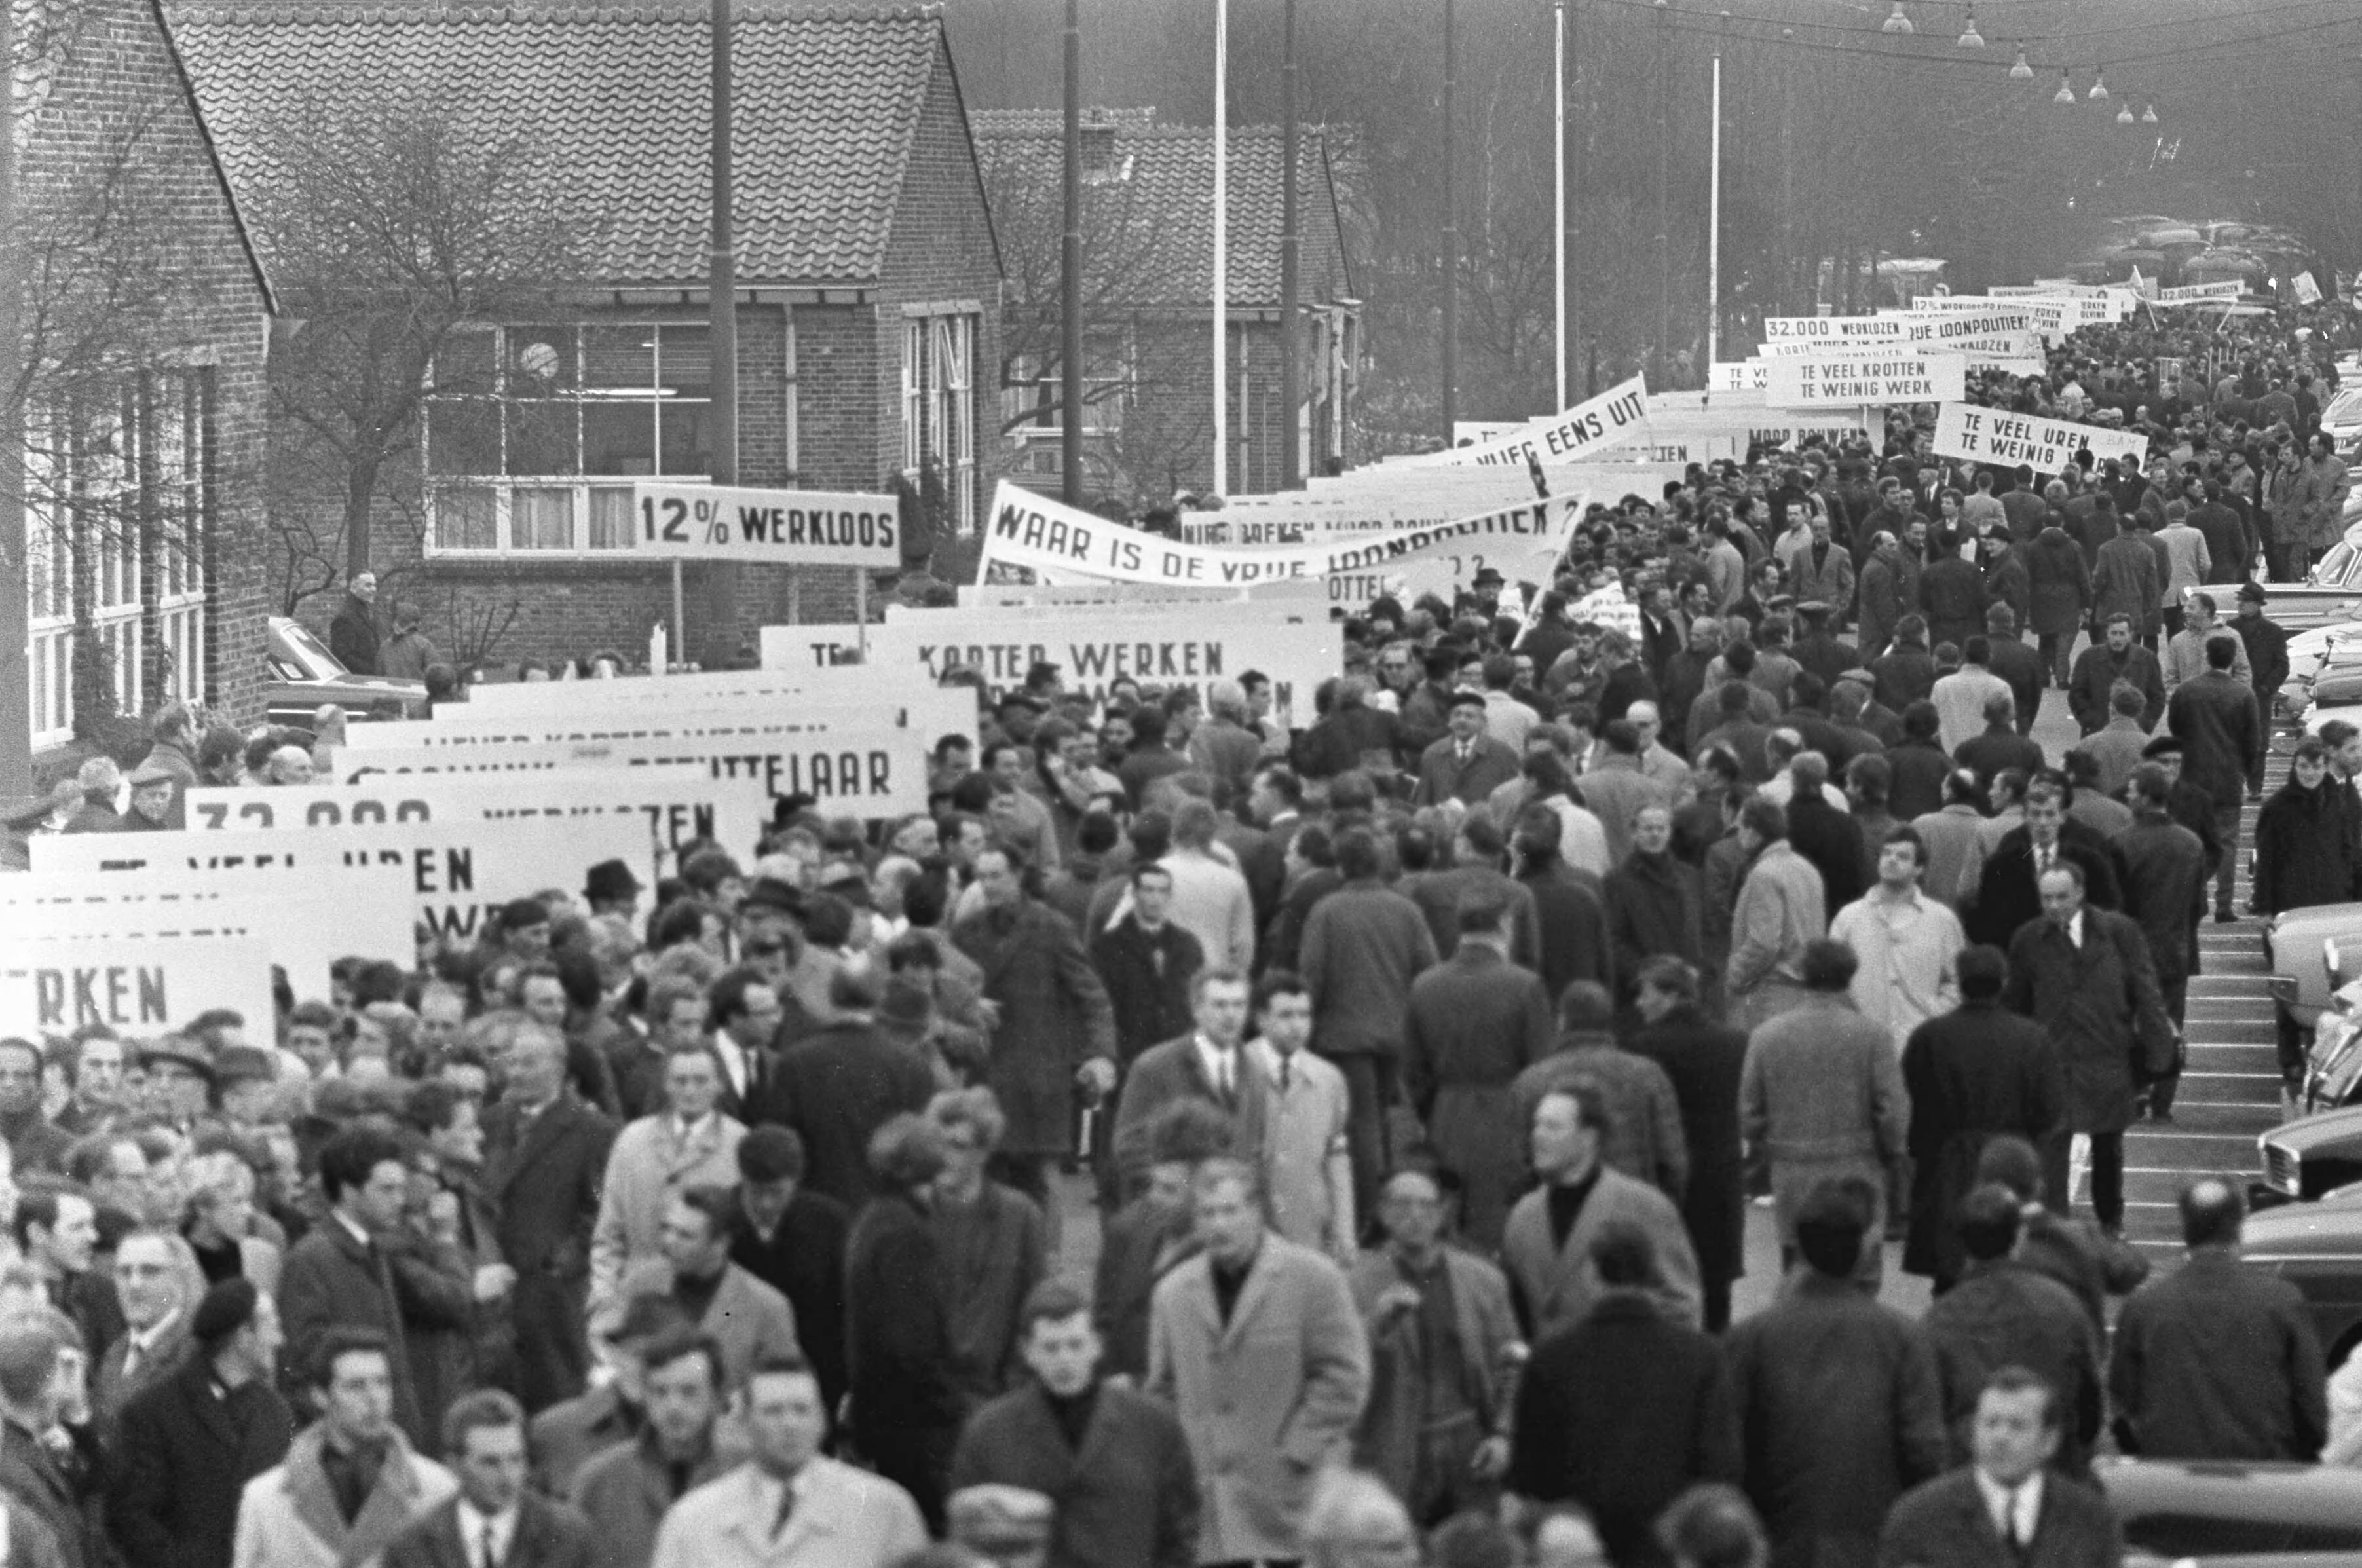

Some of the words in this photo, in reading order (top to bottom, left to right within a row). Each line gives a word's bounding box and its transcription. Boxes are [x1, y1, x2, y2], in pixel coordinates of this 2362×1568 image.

[1768, 320, 1829, 337] 32.000
[1841, 322, 1900, 335] WERKLOZEN
[1801, 365, 1816, 380] TE
[1821, 364, 1857, 379] VEEL
[1862, 361, 1926, 378] KROTTEN
[1801, 383, 1816, 398] TE
[1822, 381, 1879, 398] WEINIG
[1886, 379, 1933, 395] WERK
[1545, 411, 1605, 456] EENS
[1607, 391, 1643, 427] UIT
[1965, 413, 1982, 431] TE
[1994, 418, 2032, 441] VEEL
[2044, 427, 2090, 451] UREN
[1961, 432, 1979, 451] TE
[1990, 438, 2055, 465] WEINIG
[641, 496, 730, 545] 12%
[738, 506, 895, 548] WERKLOOS
[996, 502, 1093, 561] WAAR
[1110, 538, 1142, 571] IS
[1163, 552, 1205, 579] DE
[1070, 641, 1224, 679] WERKEN
